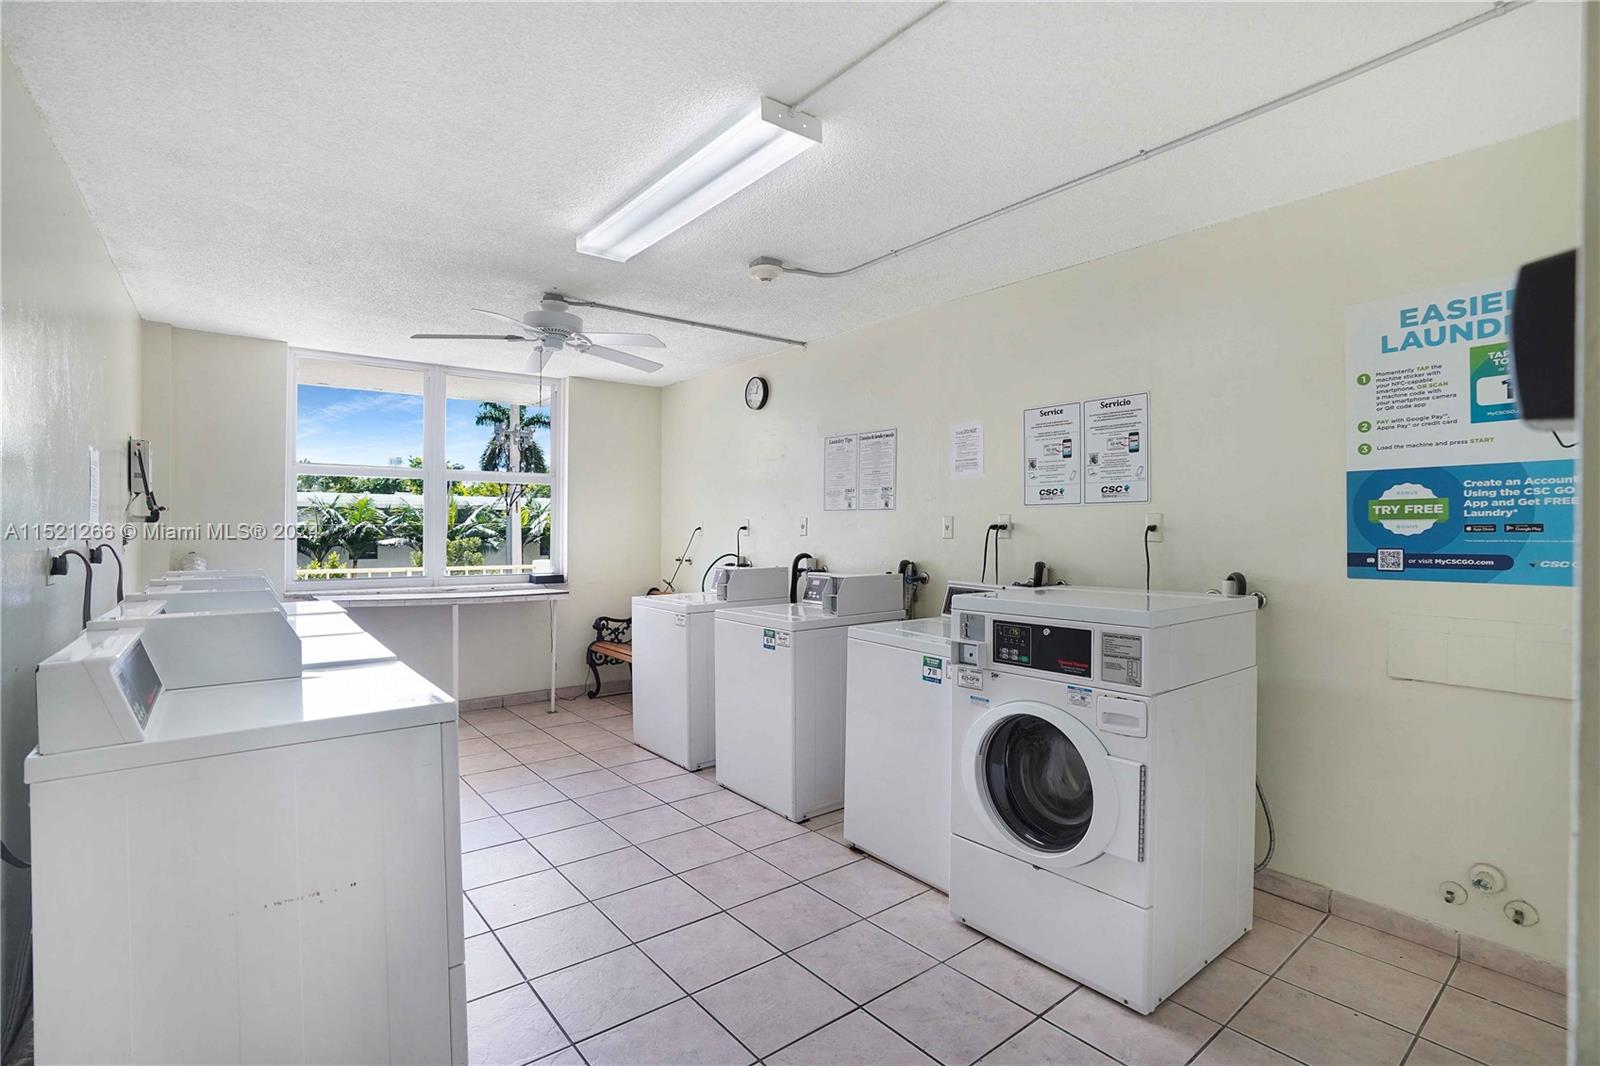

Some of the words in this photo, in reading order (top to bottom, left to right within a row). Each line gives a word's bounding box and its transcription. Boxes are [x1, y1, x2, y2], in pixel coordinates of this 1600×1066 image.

[1400, 289, 1514, 328] EASIE
[1382, 314, 1512, 354] LAUND
[1376, 368, 1415, 376] Momentarily
[1360, 375, 1367, 384] 1
[1392, 378, 1433, 386] NFC-capable
[1376, 386, 1415, 394] smartphone,
[1100, 398, 1131, 408] Servicio
[1392, 396, 1430, 404] smartphone
[1040, 408, 1064, 417] Service
[1362, 423, 1368, 431] 2
[1101, 486, 1122, 494] CSC
[1464, 489, 1496, 498] Using
[1524, 487, 1550, 495] CSC
[1464, 500, 1488, 508] App
[1372, 505, 1400, 514] TRY
[1404, 504, 1444, 514] FREE
[1434, 558, 1494, 566] MyCSCGO.com
